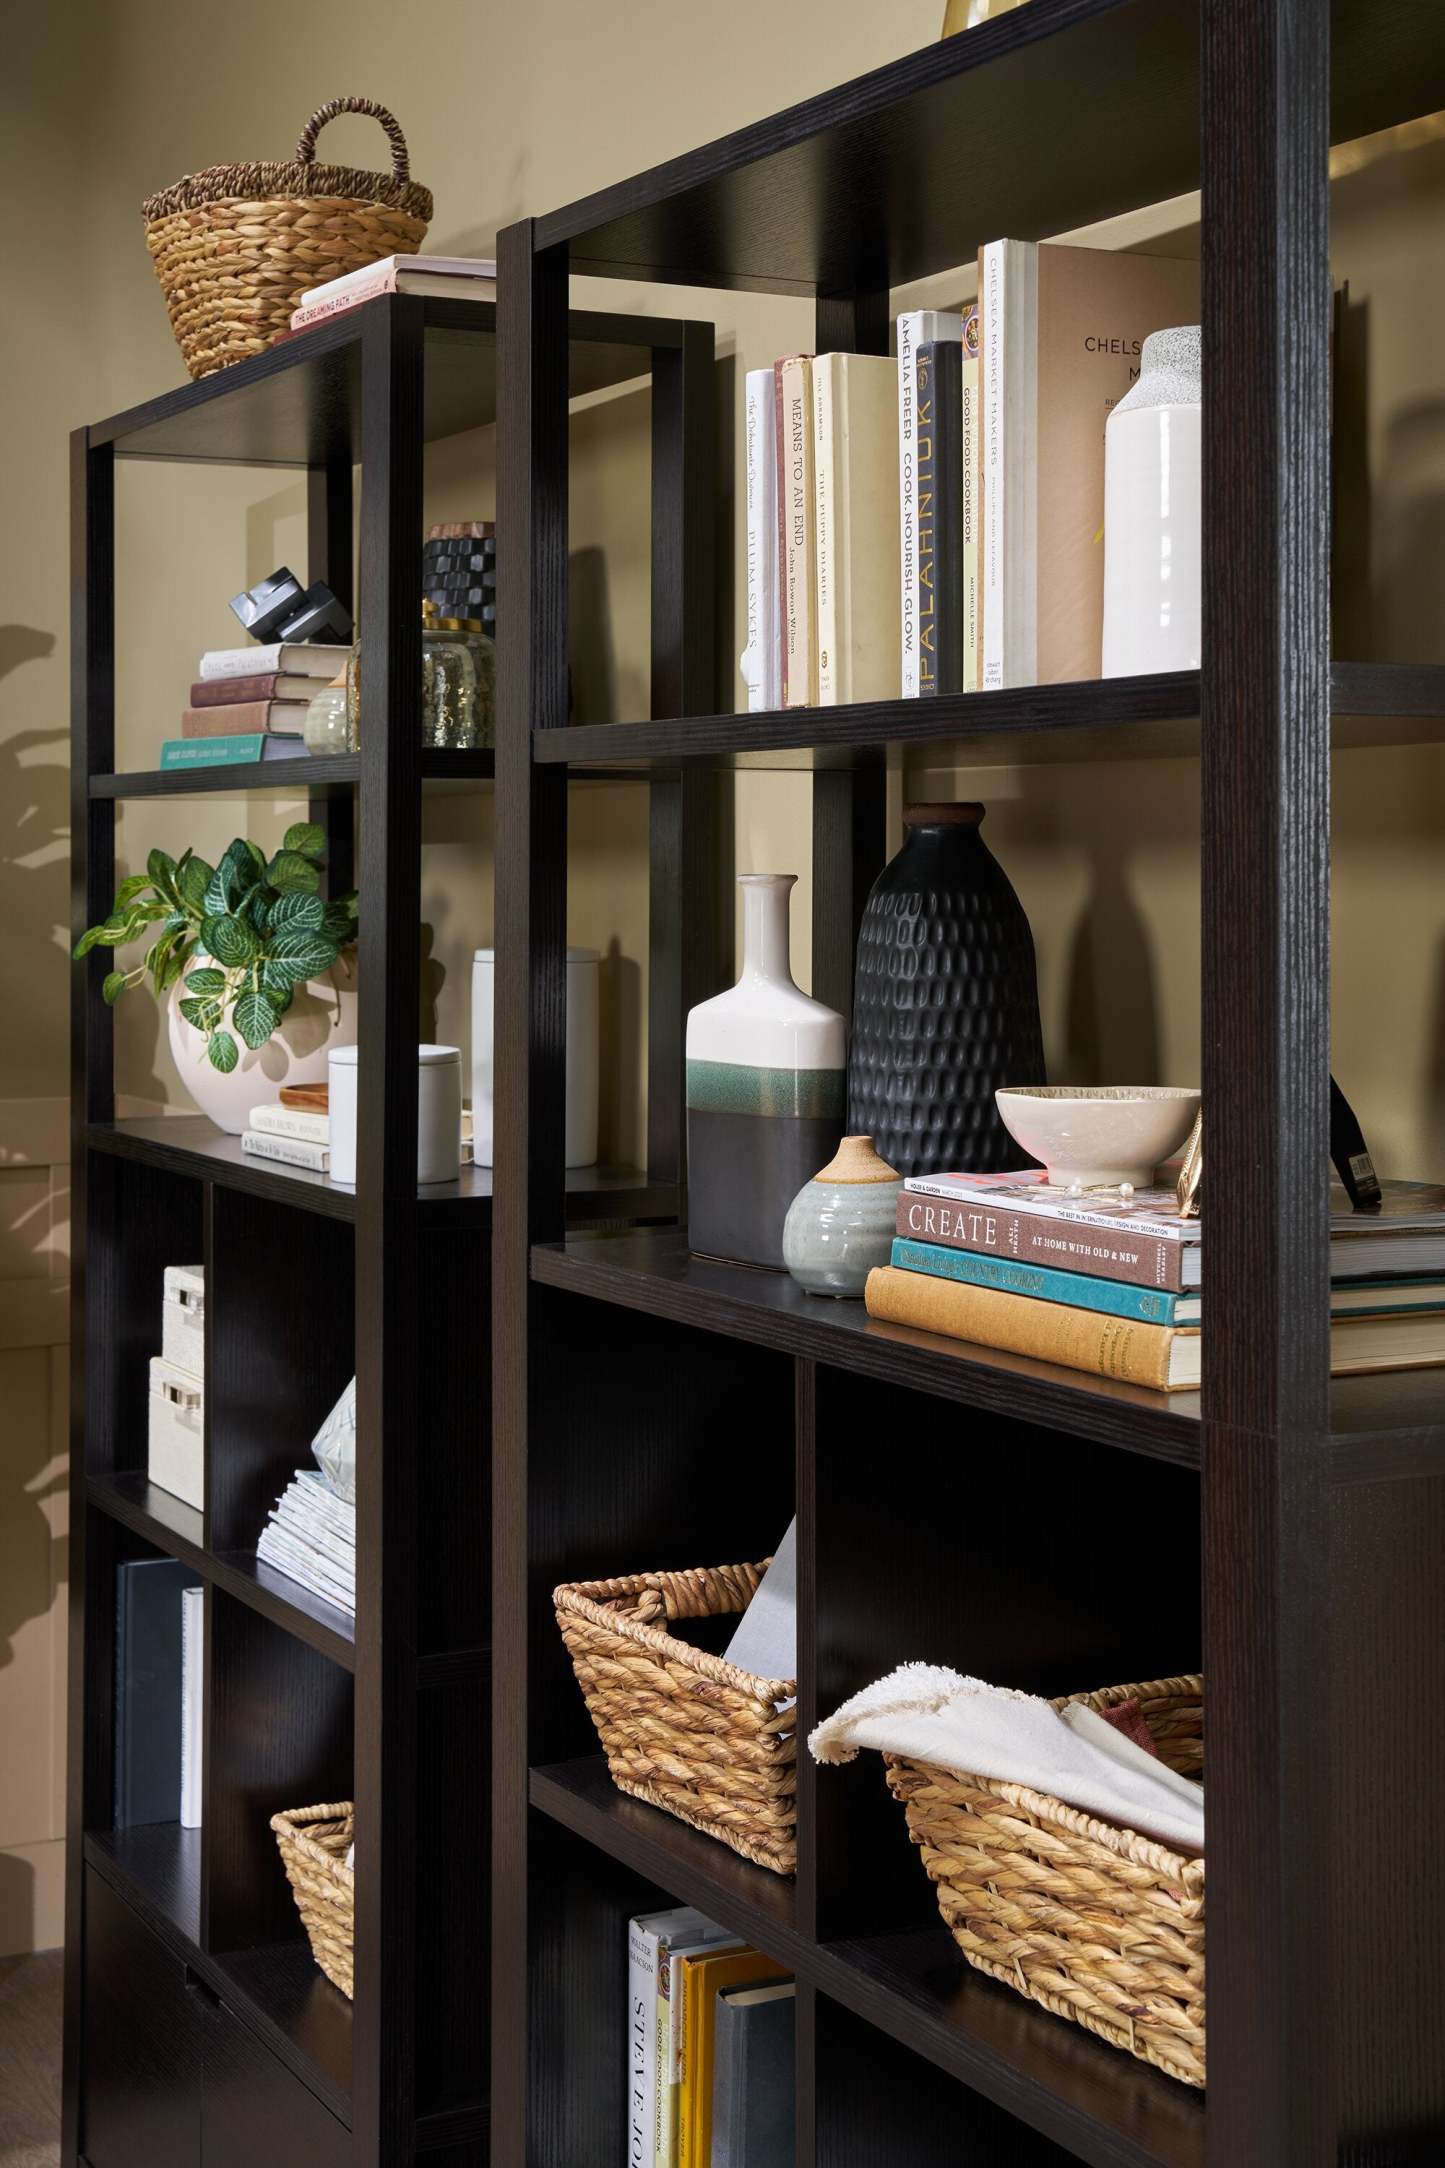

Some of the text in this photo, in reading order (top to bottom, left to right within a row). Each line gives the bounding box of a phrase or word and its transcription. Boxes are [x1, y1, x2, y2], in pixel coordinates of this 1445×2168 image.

[901, 319, 912, 440] AMELIA FREER
[792, 398, 805, 546] MEANS TO AN END
[963, 387, 972, 545] GOOD FOOD COOKBOOK
[788, 547, 796, 573] John
[917, 399, 935, 681] PALAHNIUK
[909, 1204, 997, 1245] CREATE
[1031, 1236, 1139, 1265] AT HOME WITH OLD & NEW
[1140, 1224, 1169, 1236] DECORATION
[633, 1997, 646, 2111] STEVE
